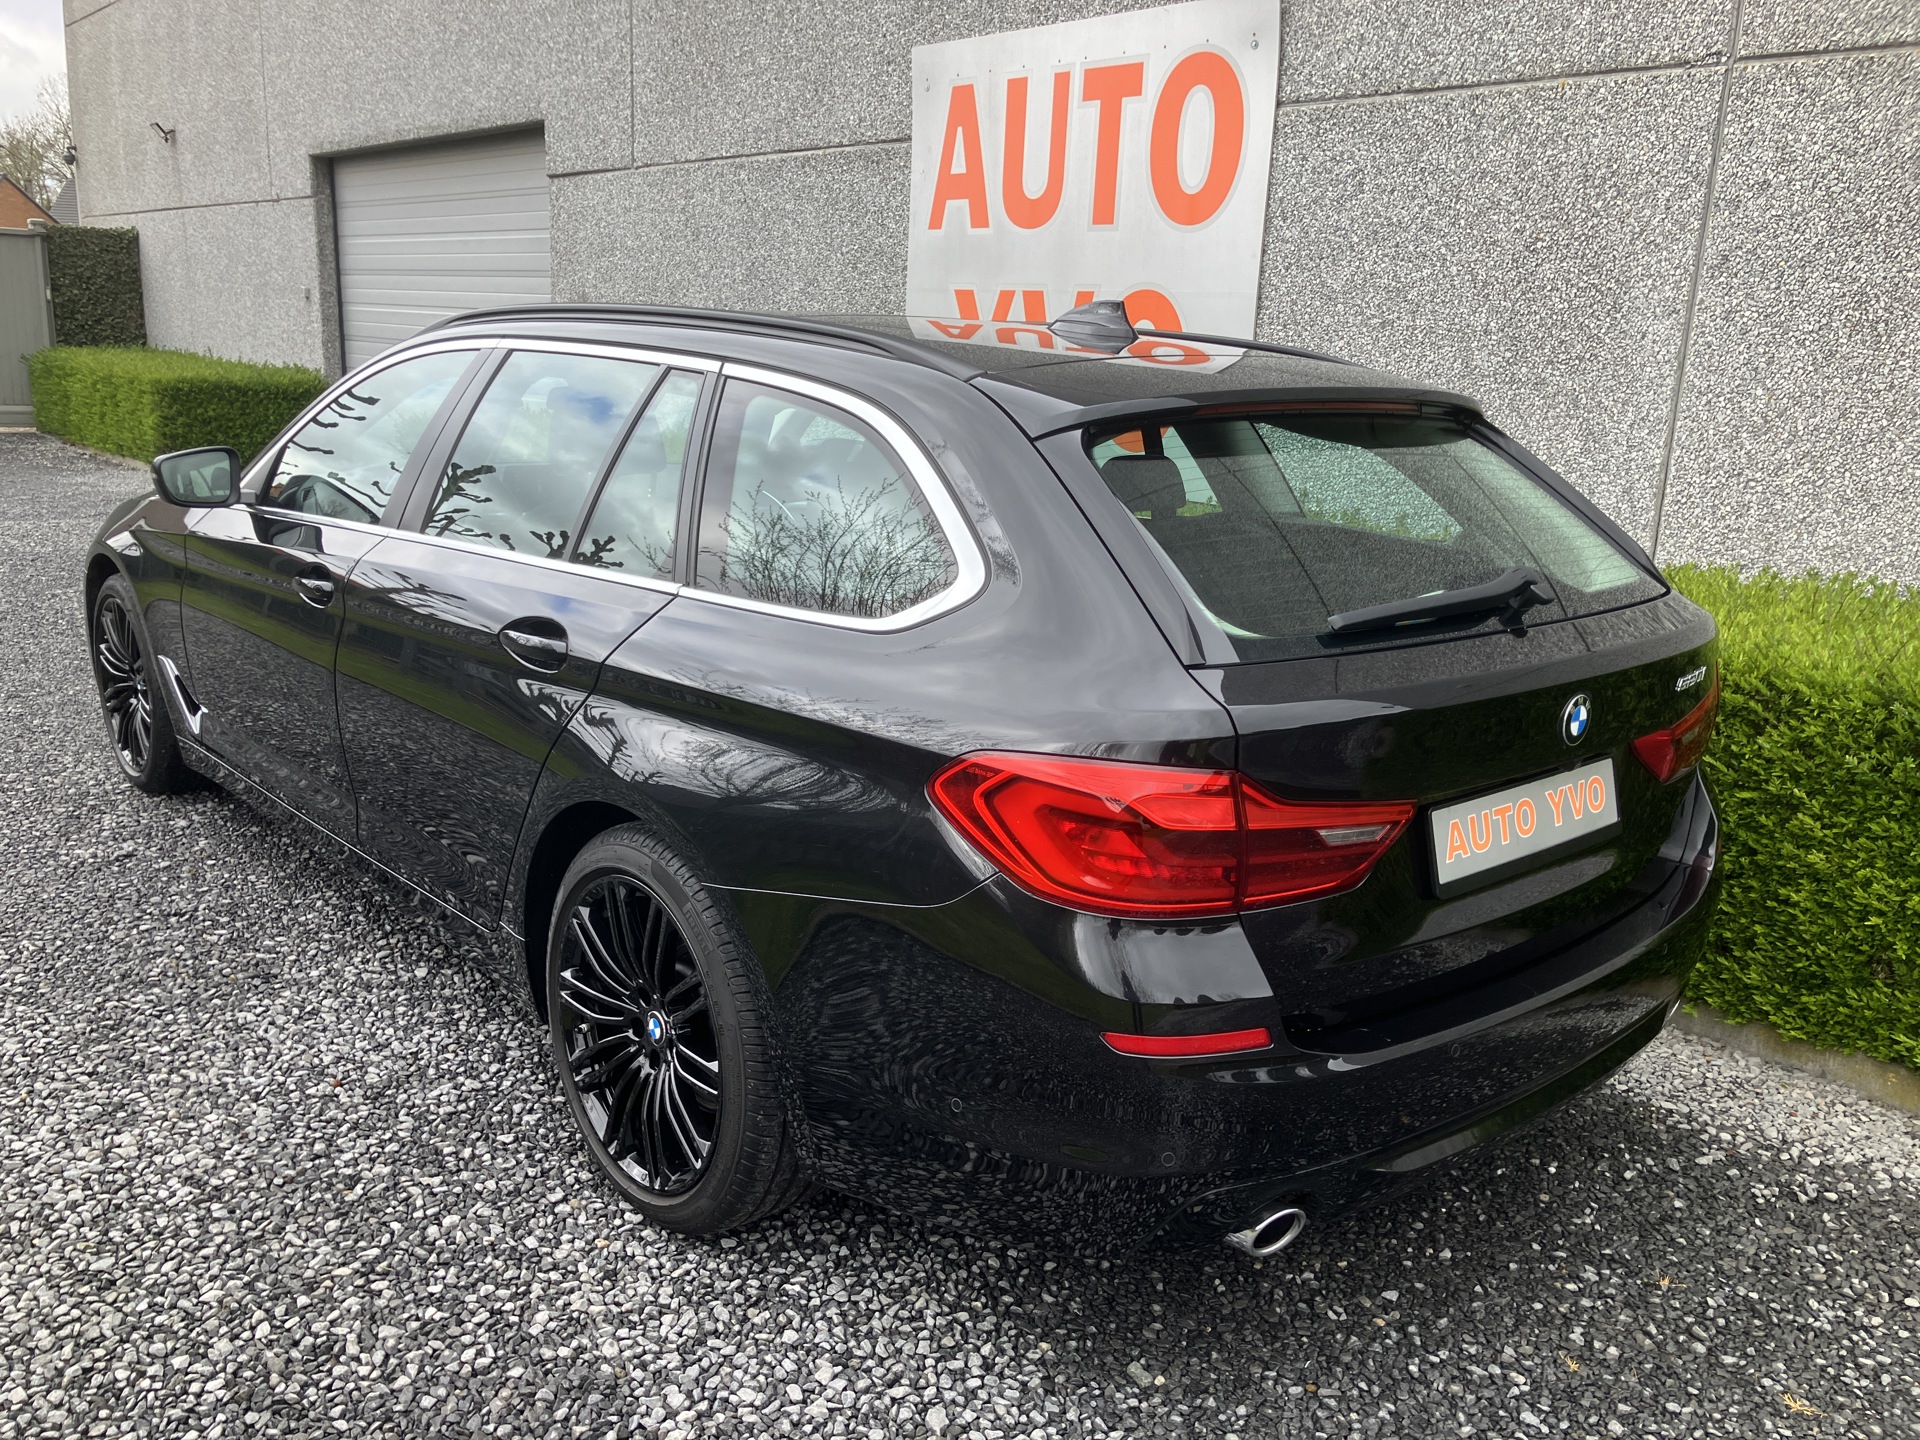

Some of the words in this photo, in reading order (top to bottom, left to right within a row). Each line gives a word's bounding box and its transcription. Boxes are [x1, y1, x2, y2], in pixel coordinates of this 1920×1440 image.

[927, 50, 1245, 231] AUTO
[1445, 797, 1537, 864] AUTO
[1545, 774, 1607, 827] YVO
